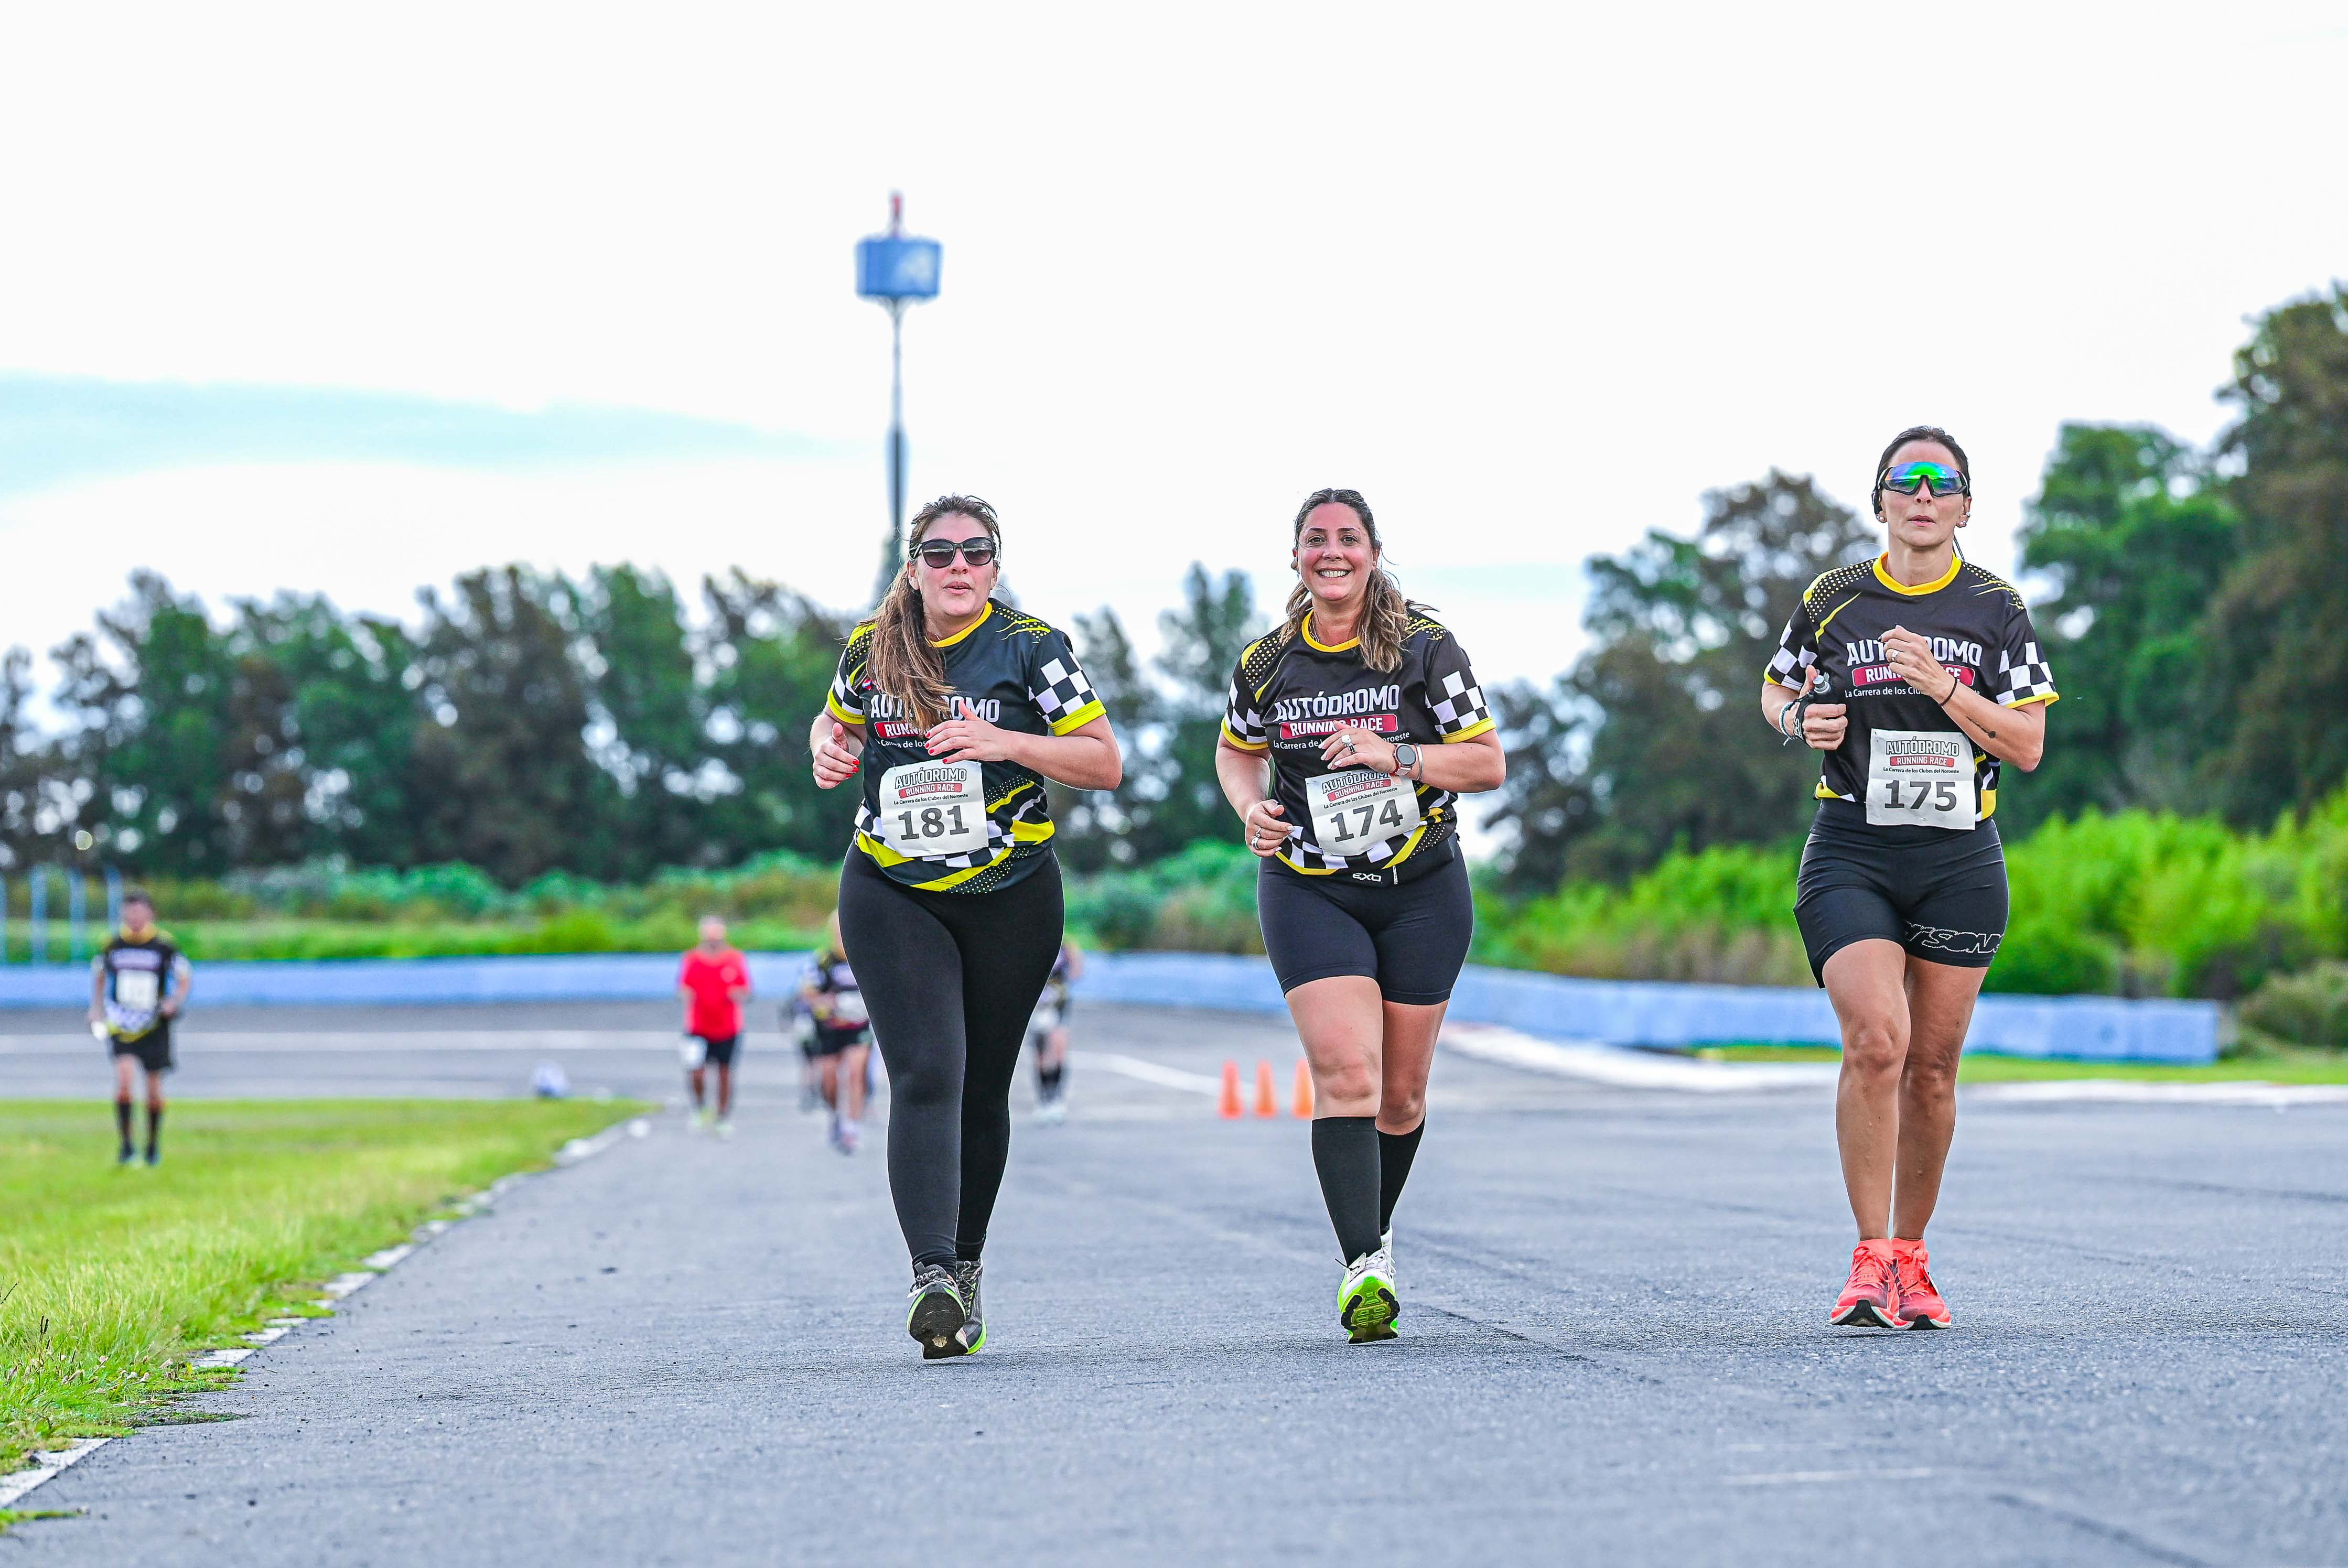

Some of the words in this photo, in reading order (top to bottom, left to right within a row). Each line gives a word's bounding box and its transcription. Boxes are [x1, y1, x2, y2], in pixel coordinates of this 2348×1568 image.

[1846, 636, 1982, 666] AUTOMO
[1273, 684, 1400, 722] AUTÓDROMO
[1350, 717, 1383, 731] RACE
[1382, 732, 1409, 743] oroeste
[1886, 736, 1959, 756] AUTÓDROMO
[1897, 756, 1928, 765] RUNNING
[1930, 756, 1947, 766] RACE
[895, 767, 967, 789] AUTÓDROMO
[1322, 772, 1390, 794] AUTÓDROM
[906, 784, 935, 796] RUNNING
[1334, 783, 1364, 798] RUNNING
[1366, 781, 1384, 789] RACE
[1884, 780, 1957, 812] 175
[898, 805, 969, 840] 181
[1330, 799, 1404, 842] 174
[1353, 873, 1382, 882] EXO
